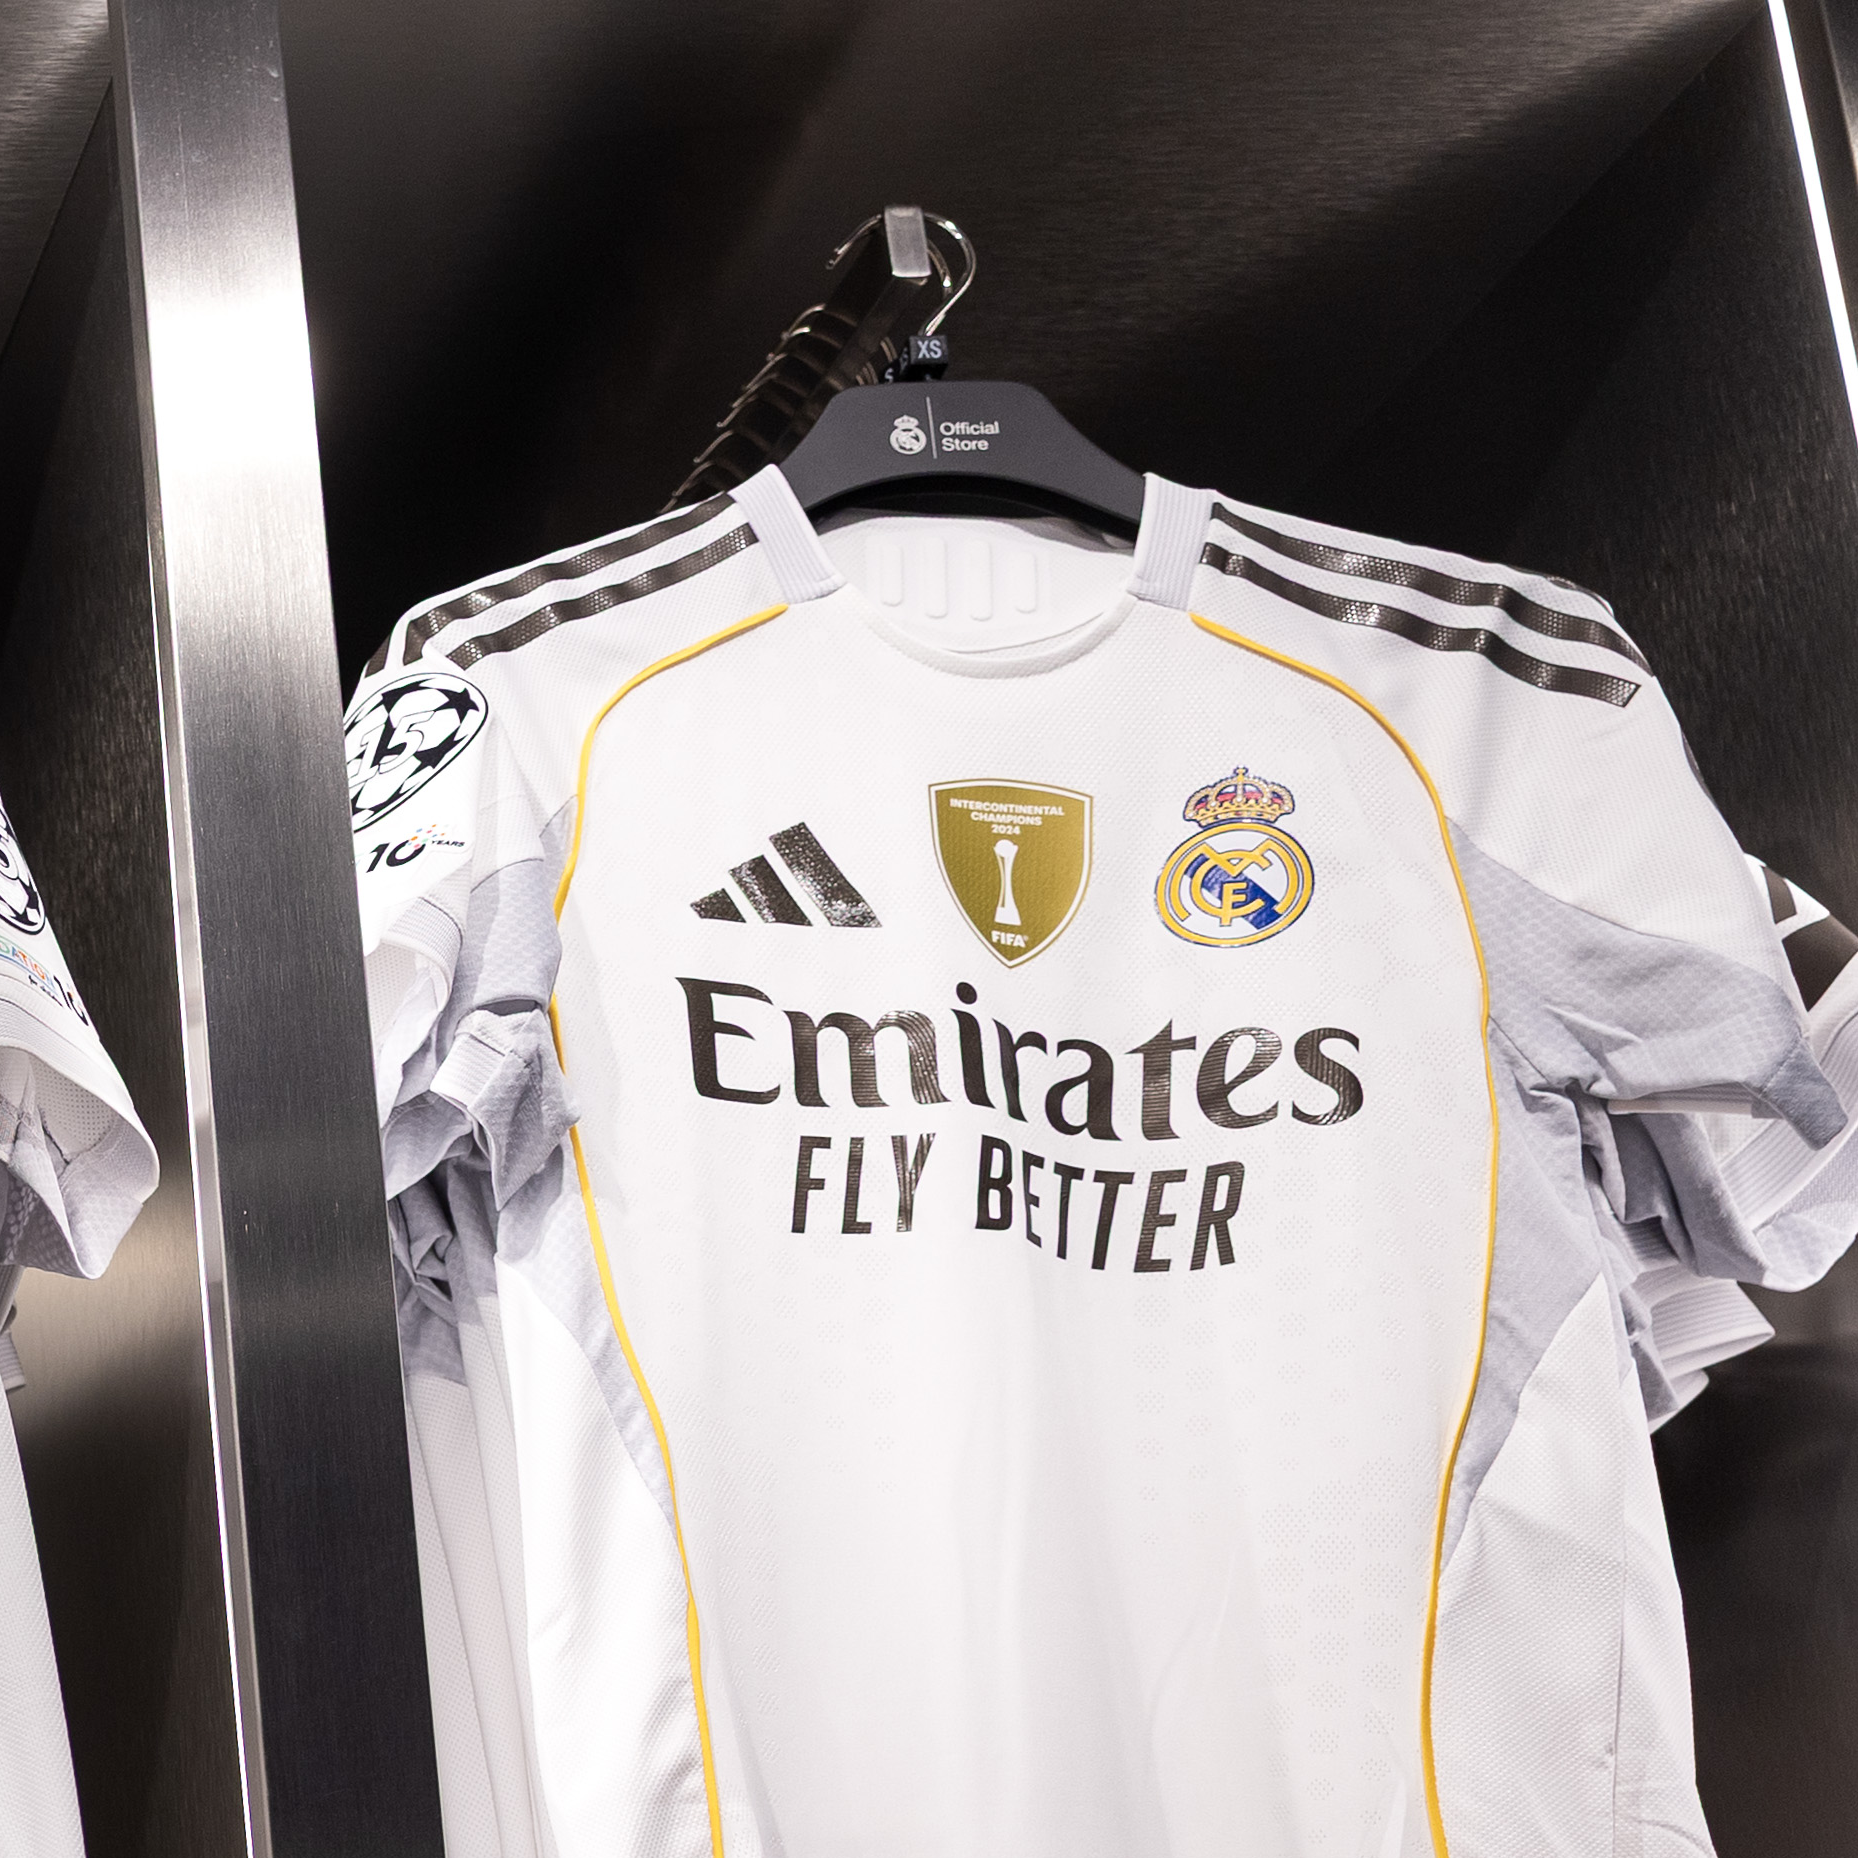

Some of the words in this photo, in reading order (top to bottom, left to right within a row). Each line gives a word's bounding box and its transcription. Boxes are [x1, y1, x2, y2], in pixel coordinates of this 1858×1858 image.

[917, 339, 943, 359] XS
[939, 420, 1001, 436] Official
[941, 437, 990, 452] Store
[347, 708, 437, 790] 15
[949, 797, 1066, 816] INTERCONTINENTAL
[970, 811, 1043, 827] CHAMPIONS
[991, 824, 1021, 835] 2024
[365, 838, 426, 873] 10
[431, 839, 465, 848] YEARS
[674, 975, 1364, 1142] Emirates
[790, 1132, 937, 1235] FLY
[974, 1133, 1246, 1274] BETTER
